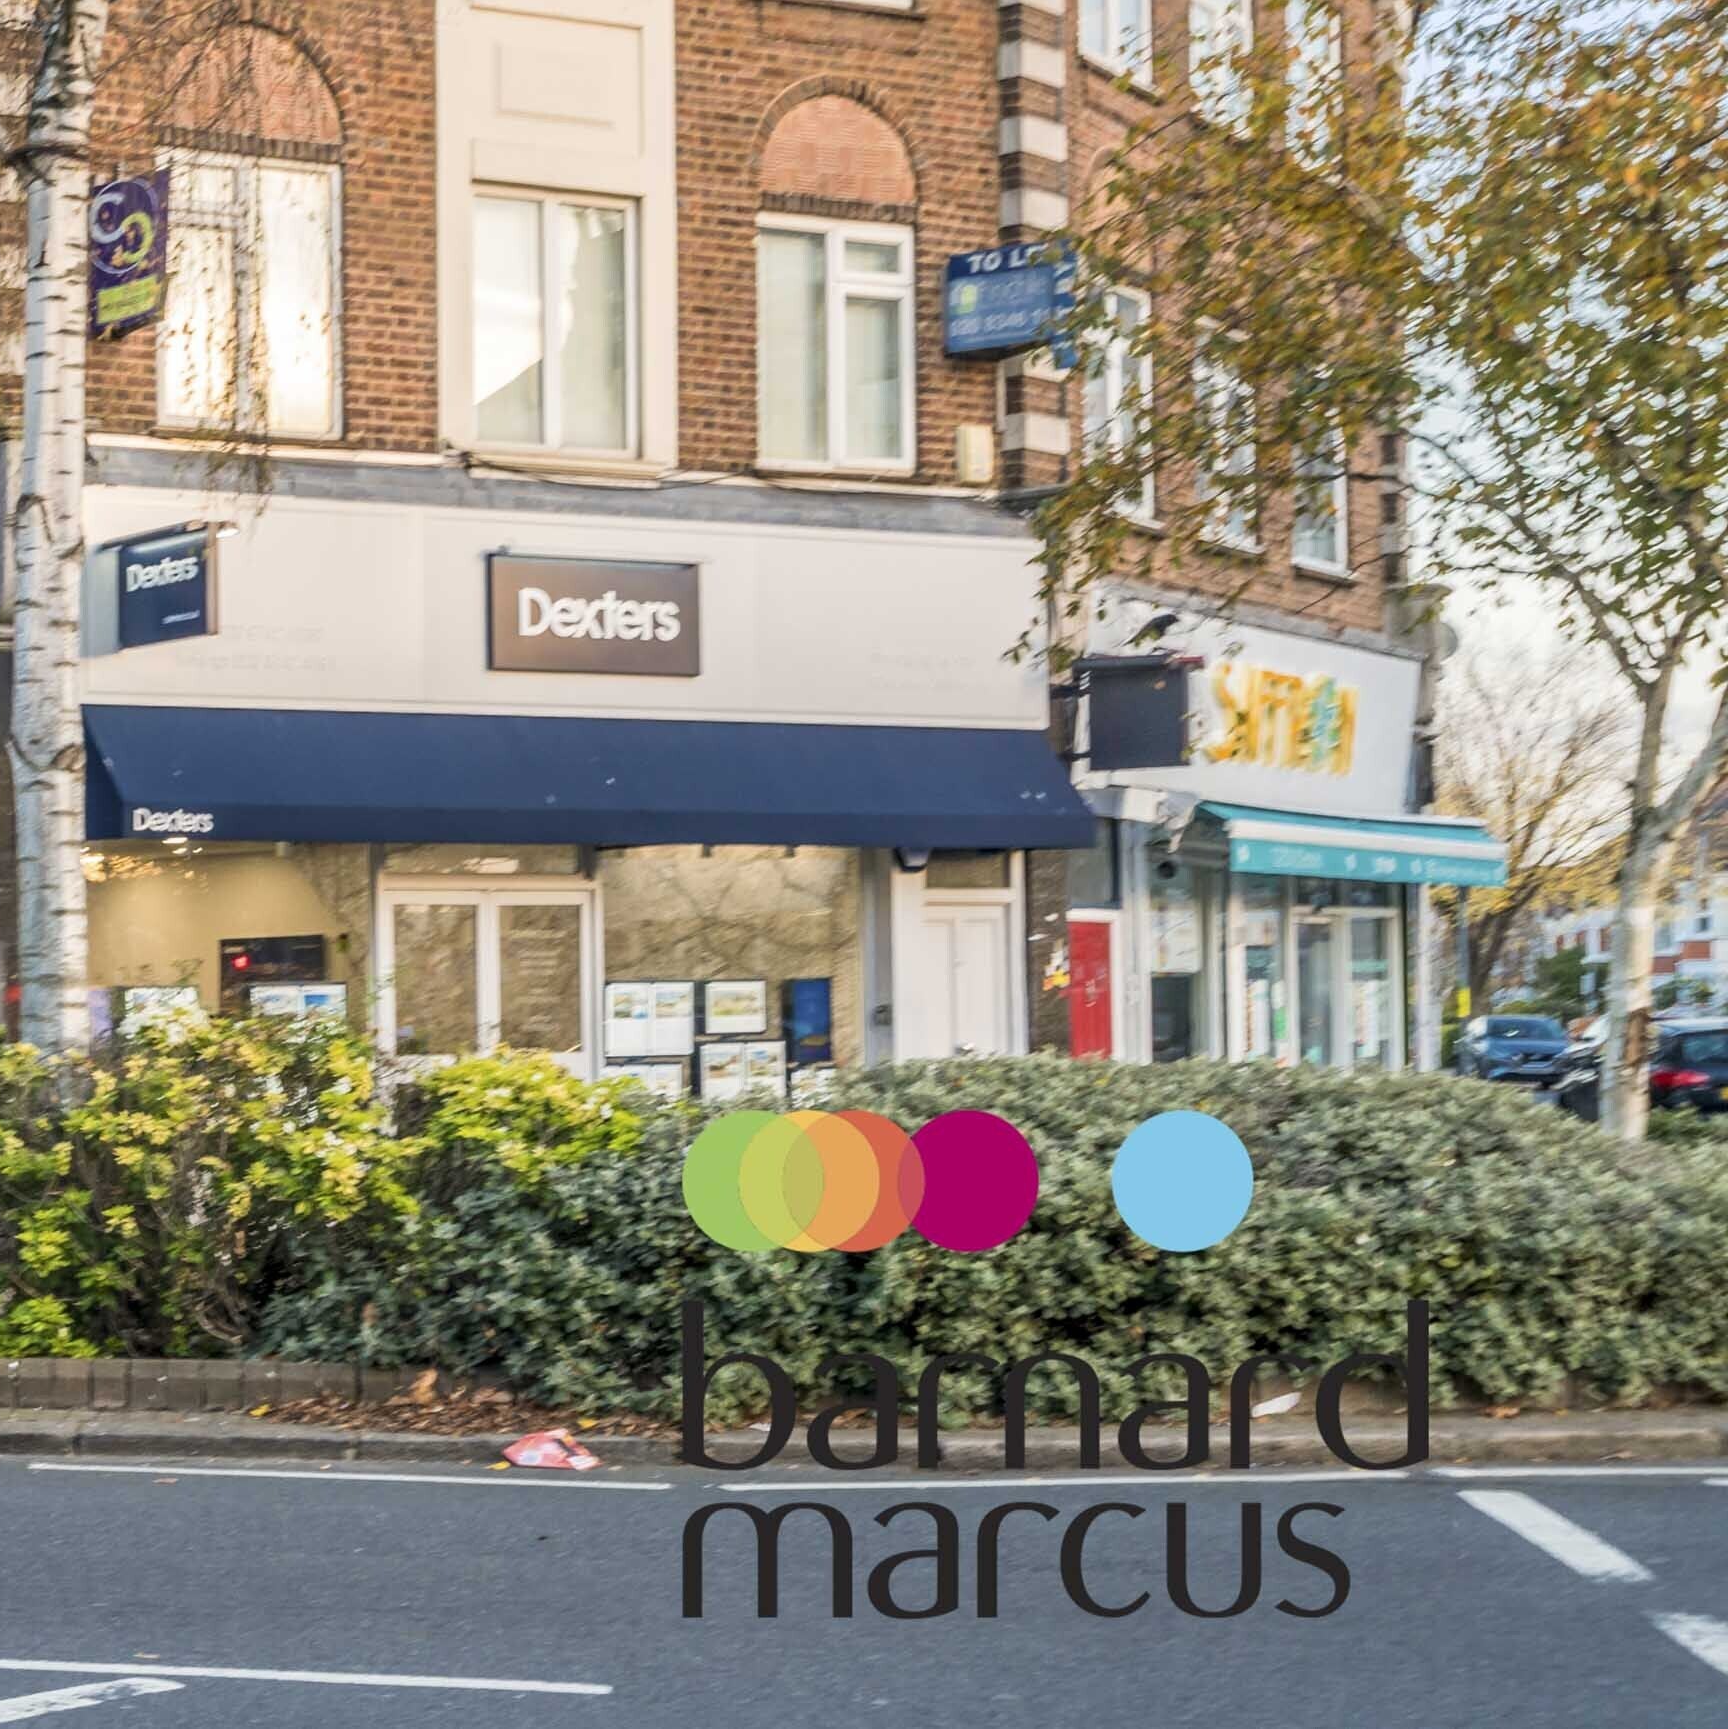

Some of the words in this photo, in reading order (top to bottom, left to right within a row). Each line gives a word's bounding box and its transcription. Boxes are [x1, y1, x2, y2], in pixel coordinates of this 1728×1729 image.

[968, 251, 1002, 274] TO
[125, 555, 200, 593] Dexters
[517, 586, 681, 642] Dexters
[132, 806, 215, 833] Dexters
